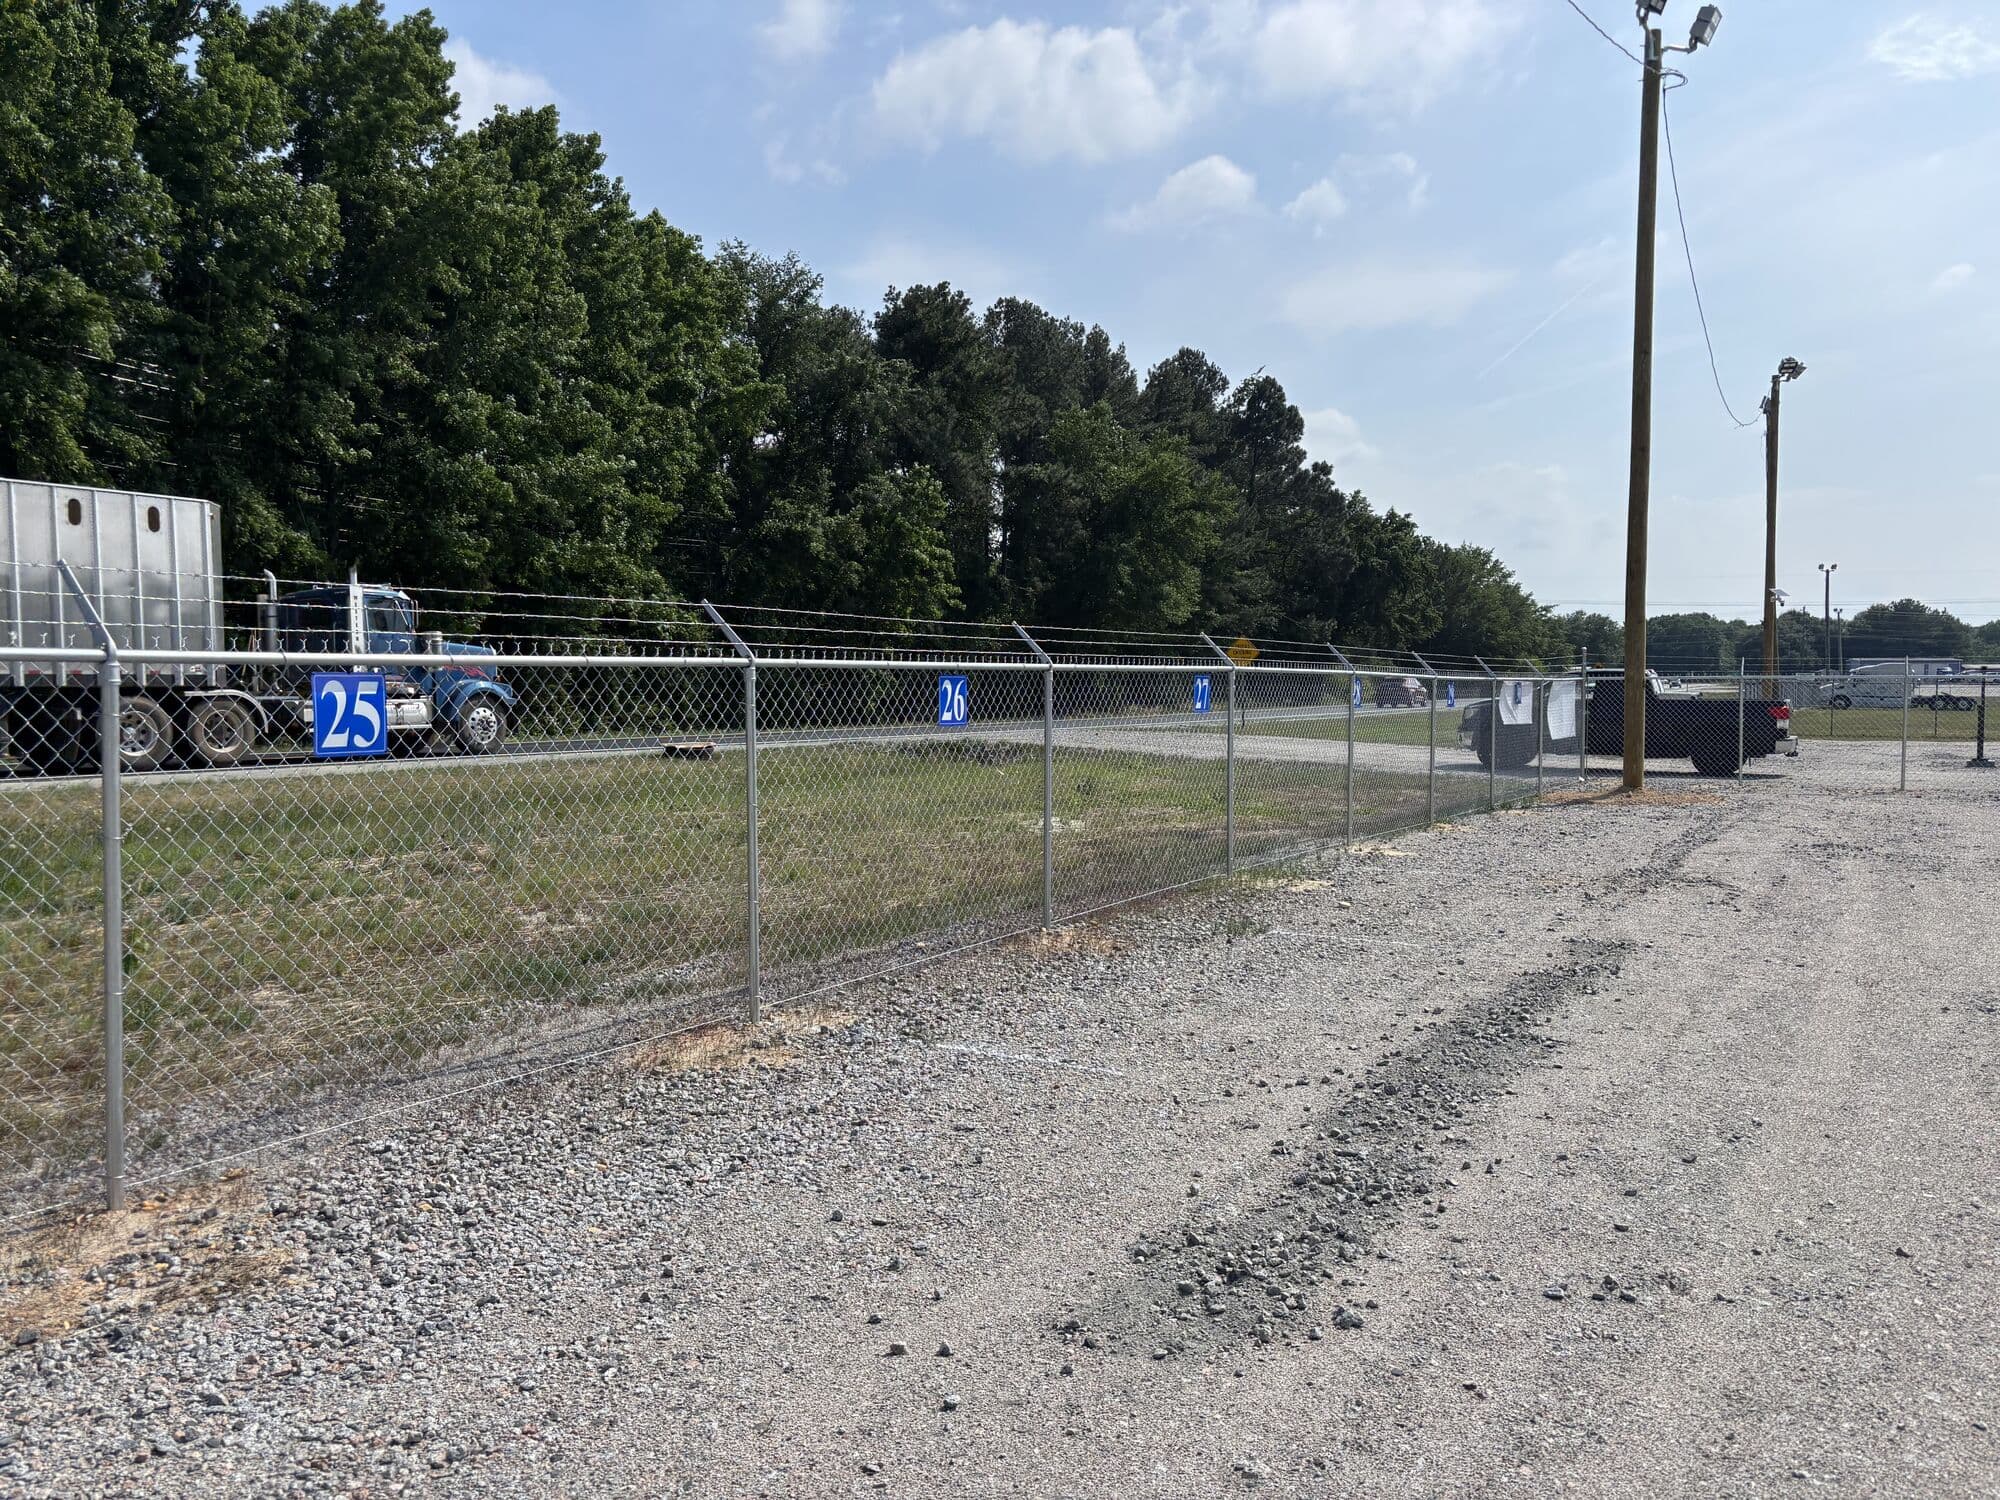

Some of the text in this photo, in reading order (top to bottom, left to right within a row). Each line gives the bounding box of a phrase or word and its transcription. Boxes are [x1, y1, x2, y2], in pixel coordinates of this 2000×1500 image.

[321, 680, 380, 748] 25
[941, 679, 965, 721] 26
[1195, 678, 1209, 709] 27
